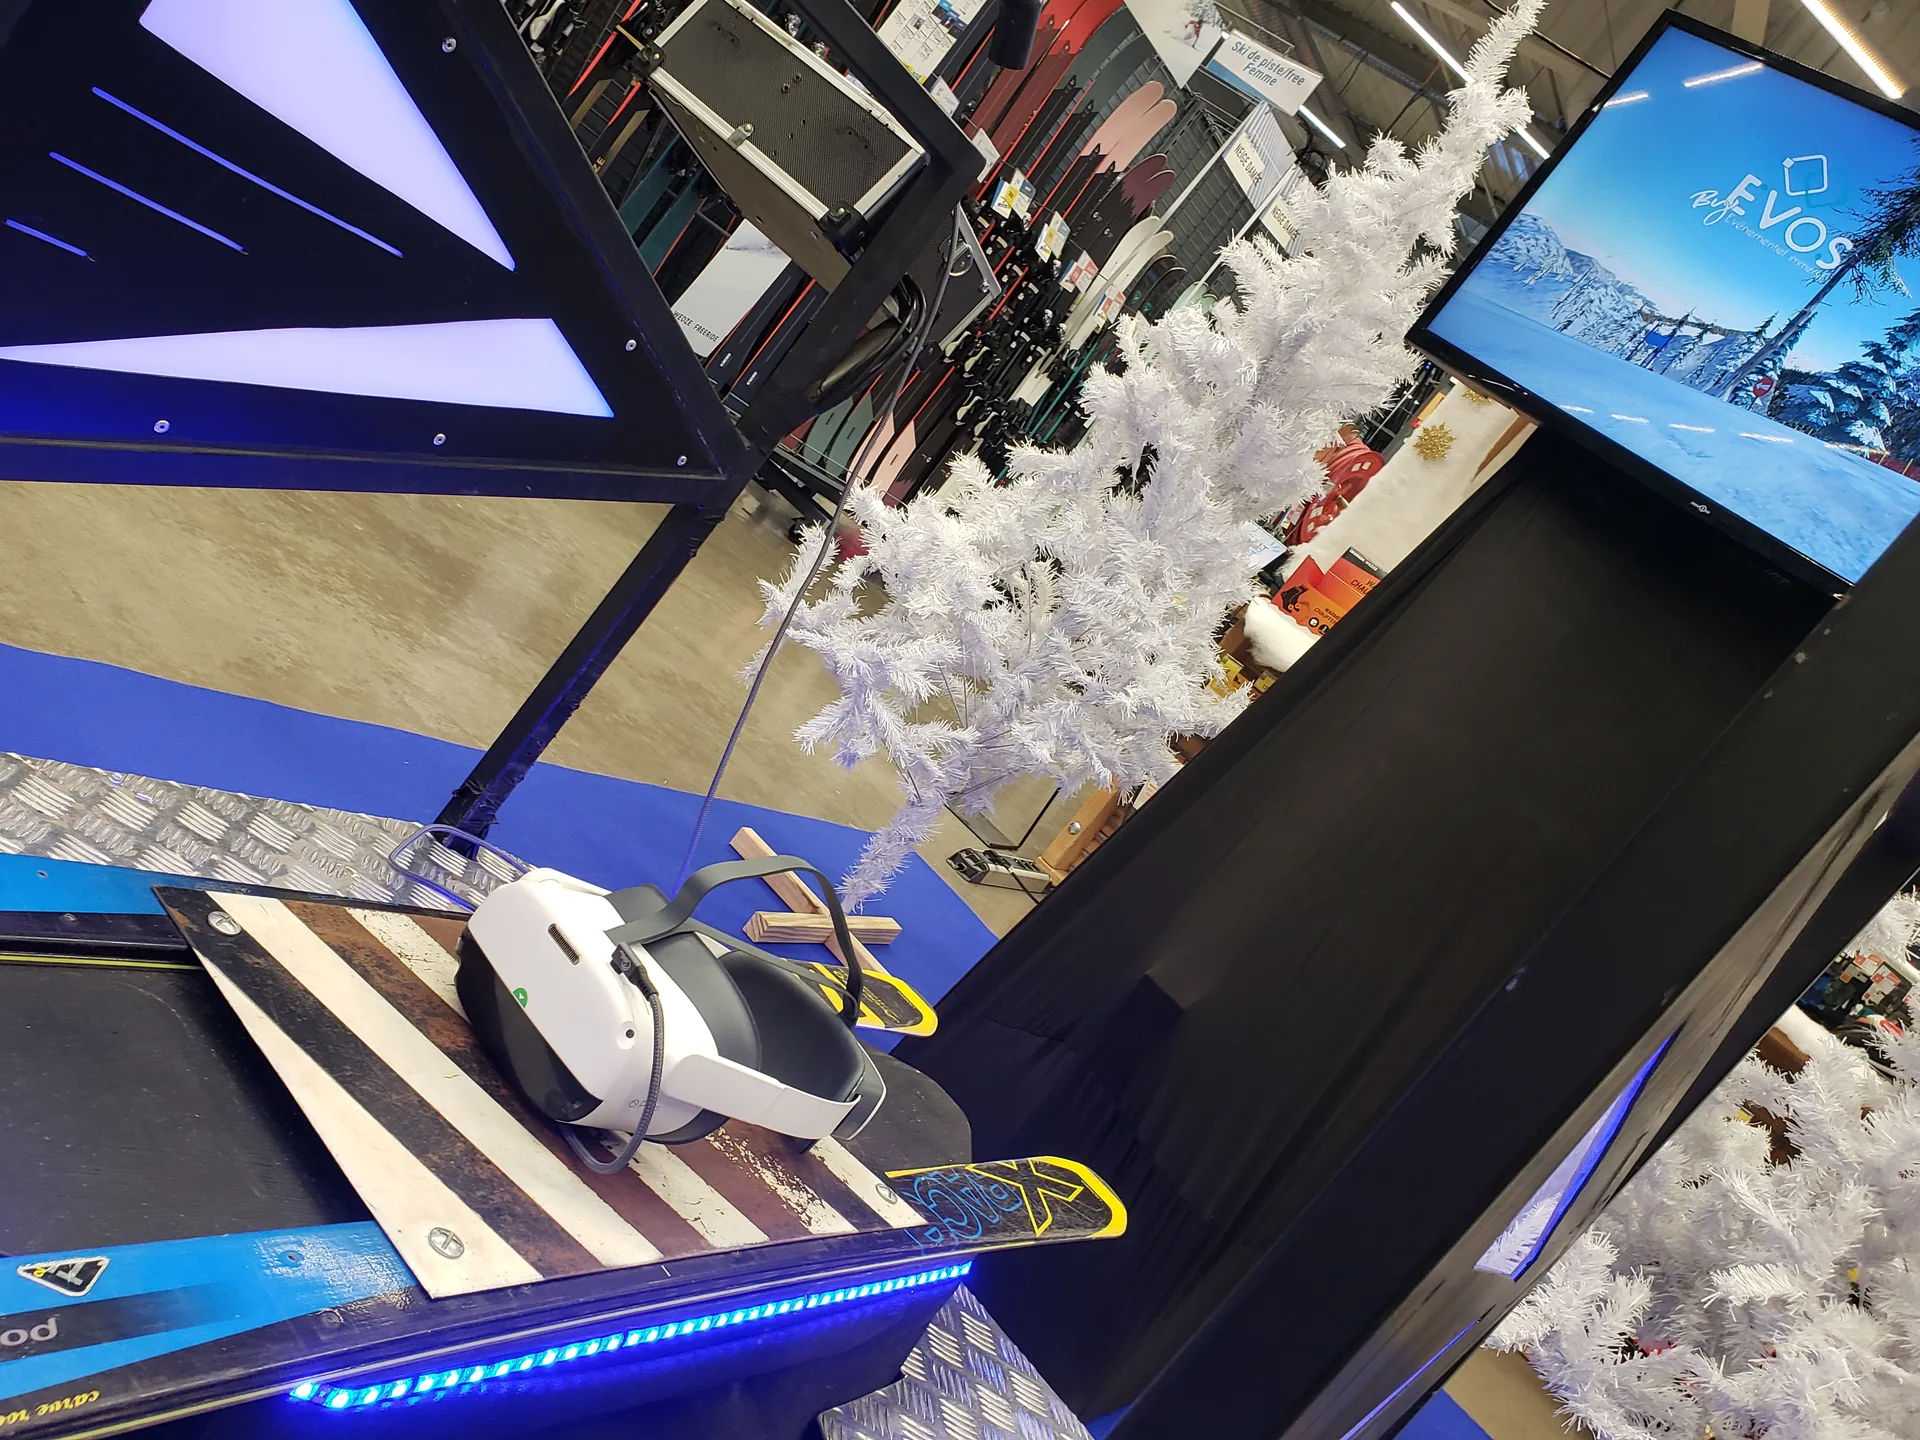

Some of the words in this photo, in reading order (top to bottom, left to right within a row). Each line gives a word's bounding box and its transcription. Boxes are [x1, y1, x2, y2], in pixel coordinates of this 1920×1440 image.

[1231, 41, 1251, 56] Ski
[1247, 50, 1261, 62] de
[1257, 58, 1305, 86] piste/free
[1242, 62, 1277, 86] Femme
[1234, 143, 1250, 164] NEIGE
[1270, 205, 1287, 226] NEIGE
[1690, 190, 1739, 226] By
[1727, 173, 1854, 270] EVOS
[673, 310, 694, 327] WEDZE
[693, 323, 720, 343] FREERIDE
[36, 1390, 101, 1417] carve
